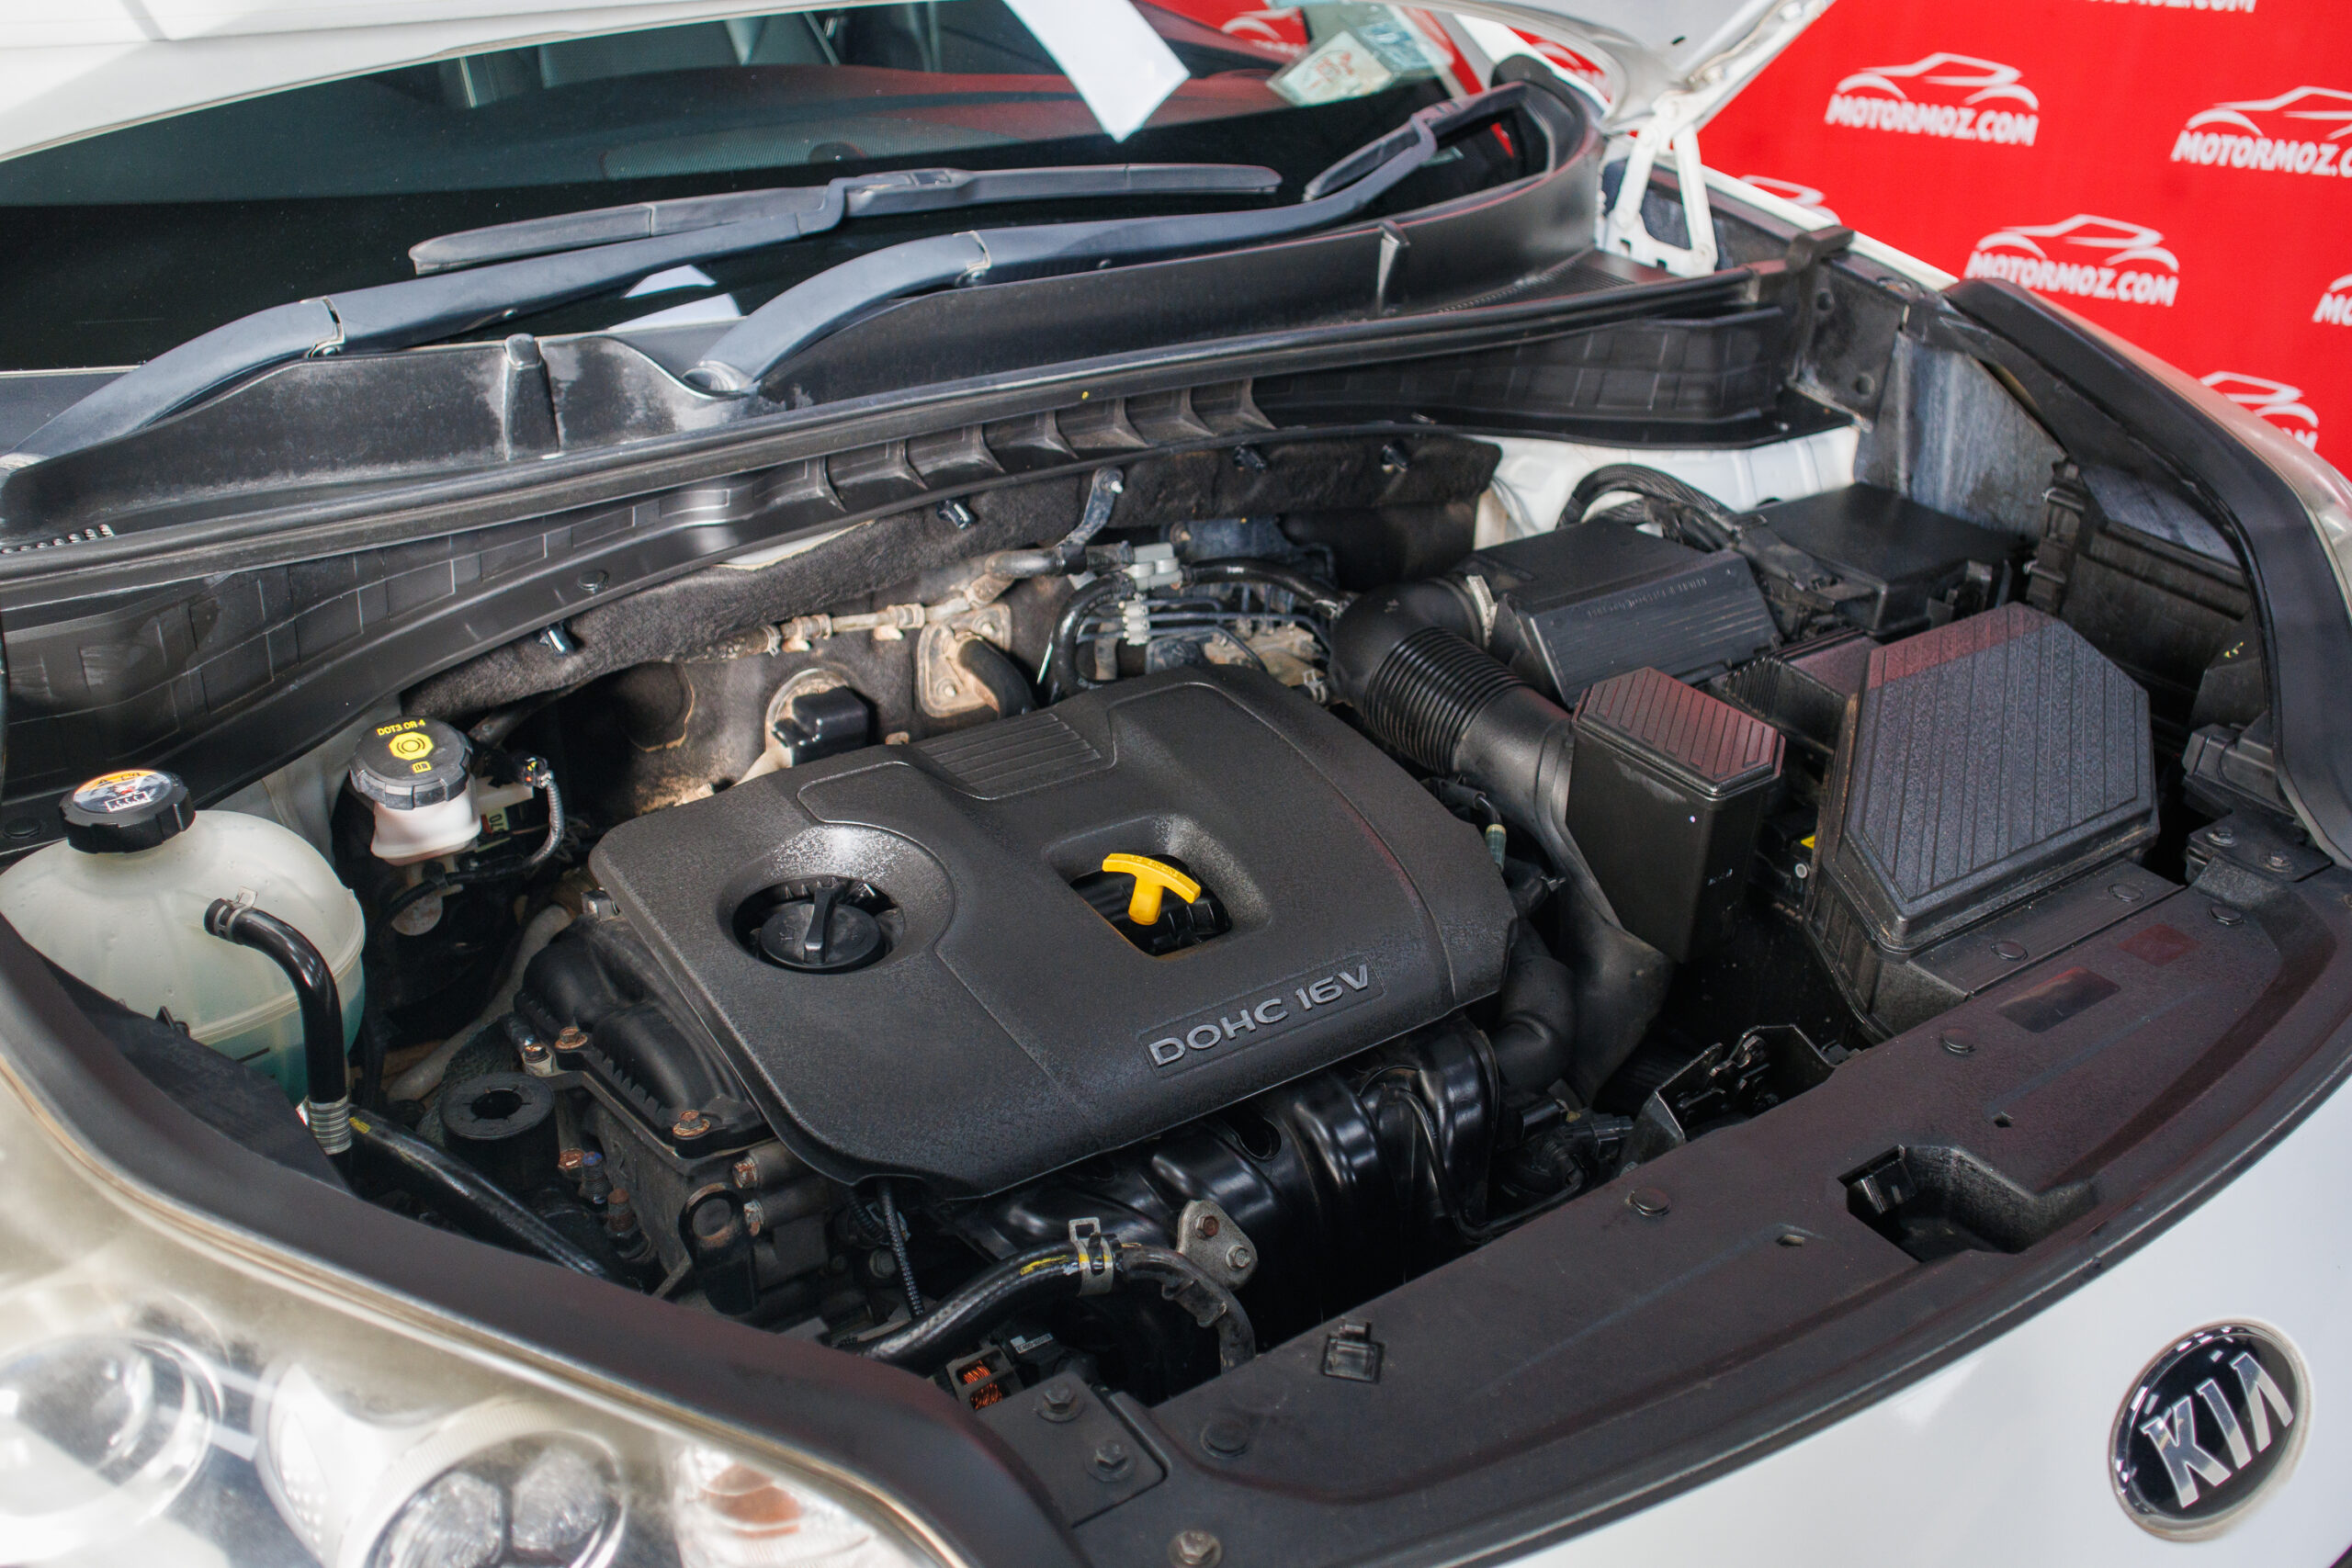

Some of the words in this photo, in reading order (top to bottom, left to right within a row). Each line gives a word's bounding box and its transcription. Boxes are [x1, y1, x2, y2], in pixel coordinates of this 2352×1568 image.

[1825, 94, 2040, 146] MOTORMOZ.COM
[1963, 251, 2179, 307] MOTORMOZ.COM
[376, 724, 403, 736] DOT3
[403, 720, 418, 729] OR
[418, 718, 426, 727] 4
[1148, 998, 1288, 1067] DOHC
[1295, 964, 1368, 1011] 16V
[2140, 1351, 2294, 1508] KIA
